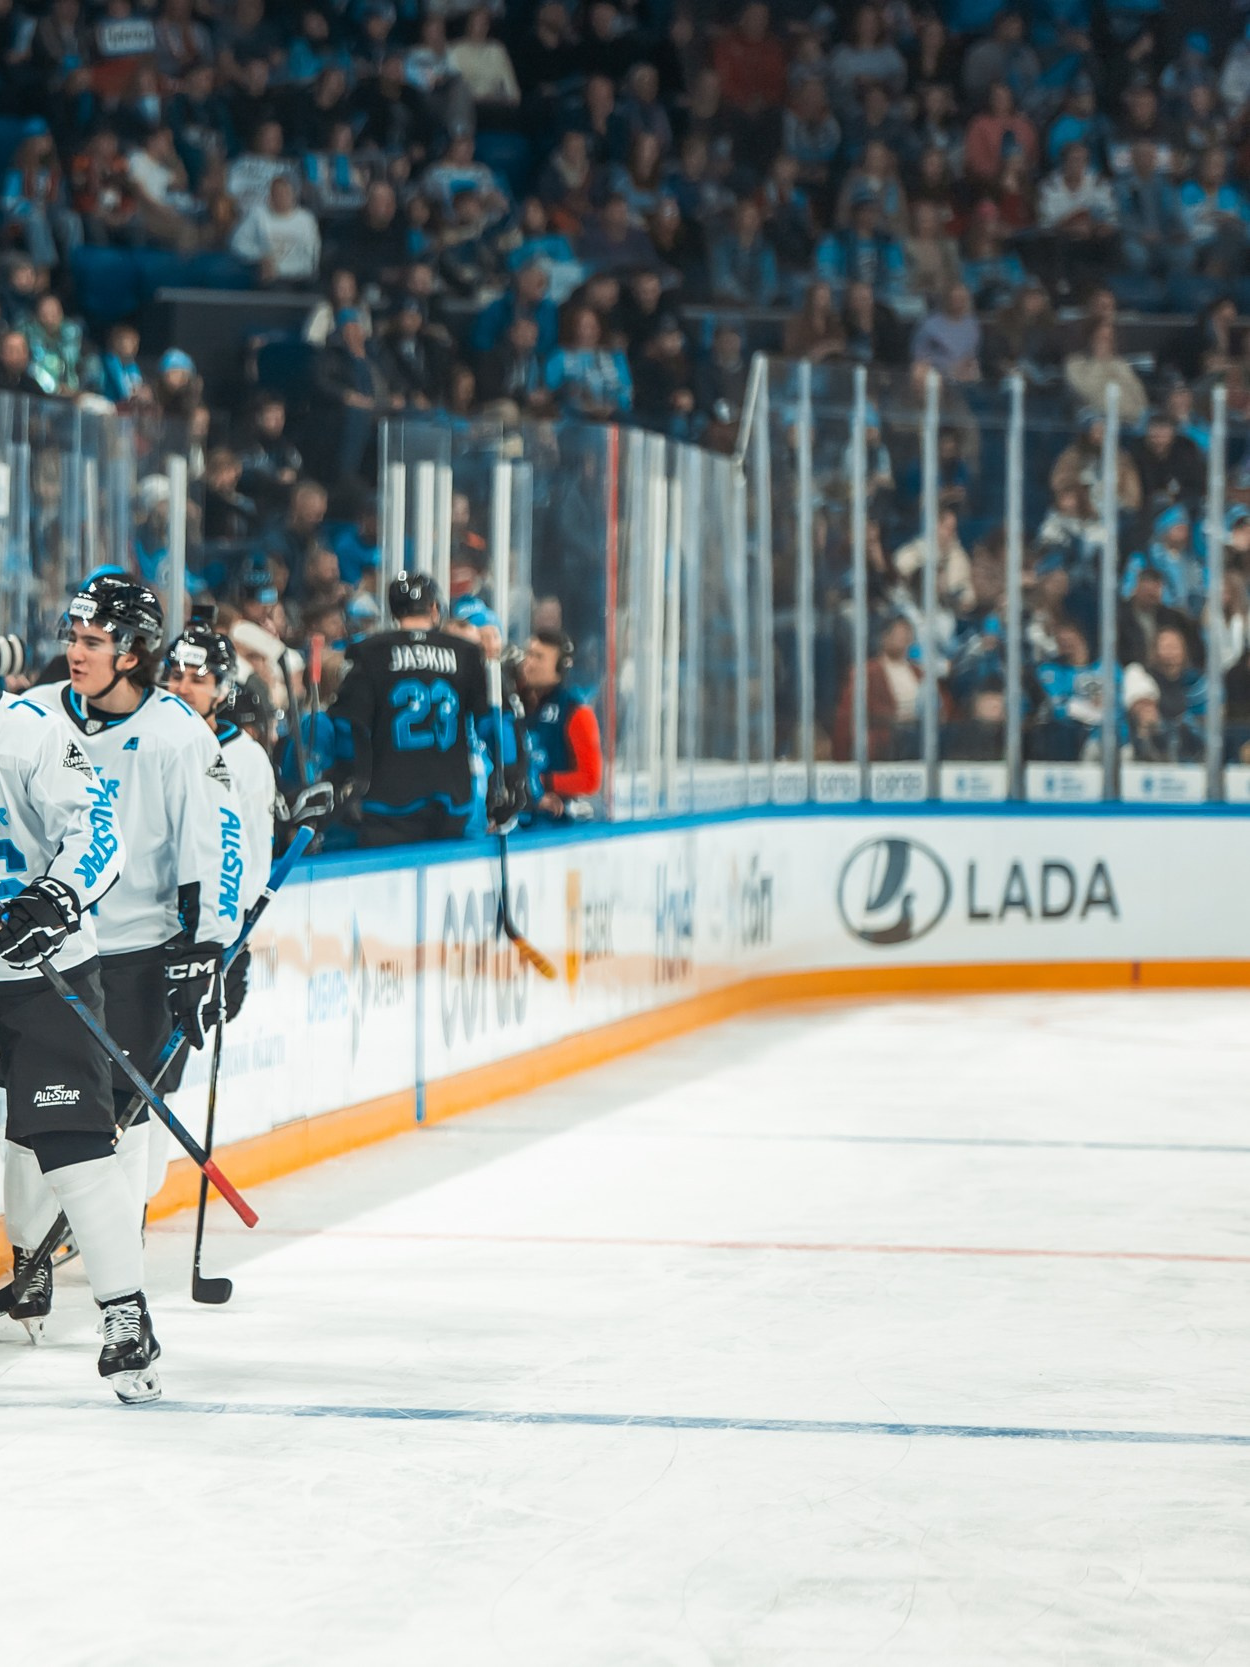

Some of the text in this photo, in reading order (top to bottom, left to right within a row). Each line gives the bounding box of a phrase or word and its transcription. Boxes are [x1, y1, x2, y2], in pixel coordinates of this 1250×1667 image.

[388, 678, 459, 752] 23
[38, 880, 79, 924] CM
[967, 858, 1119, 921] LADA
[165, 958, 217, 981] CM
